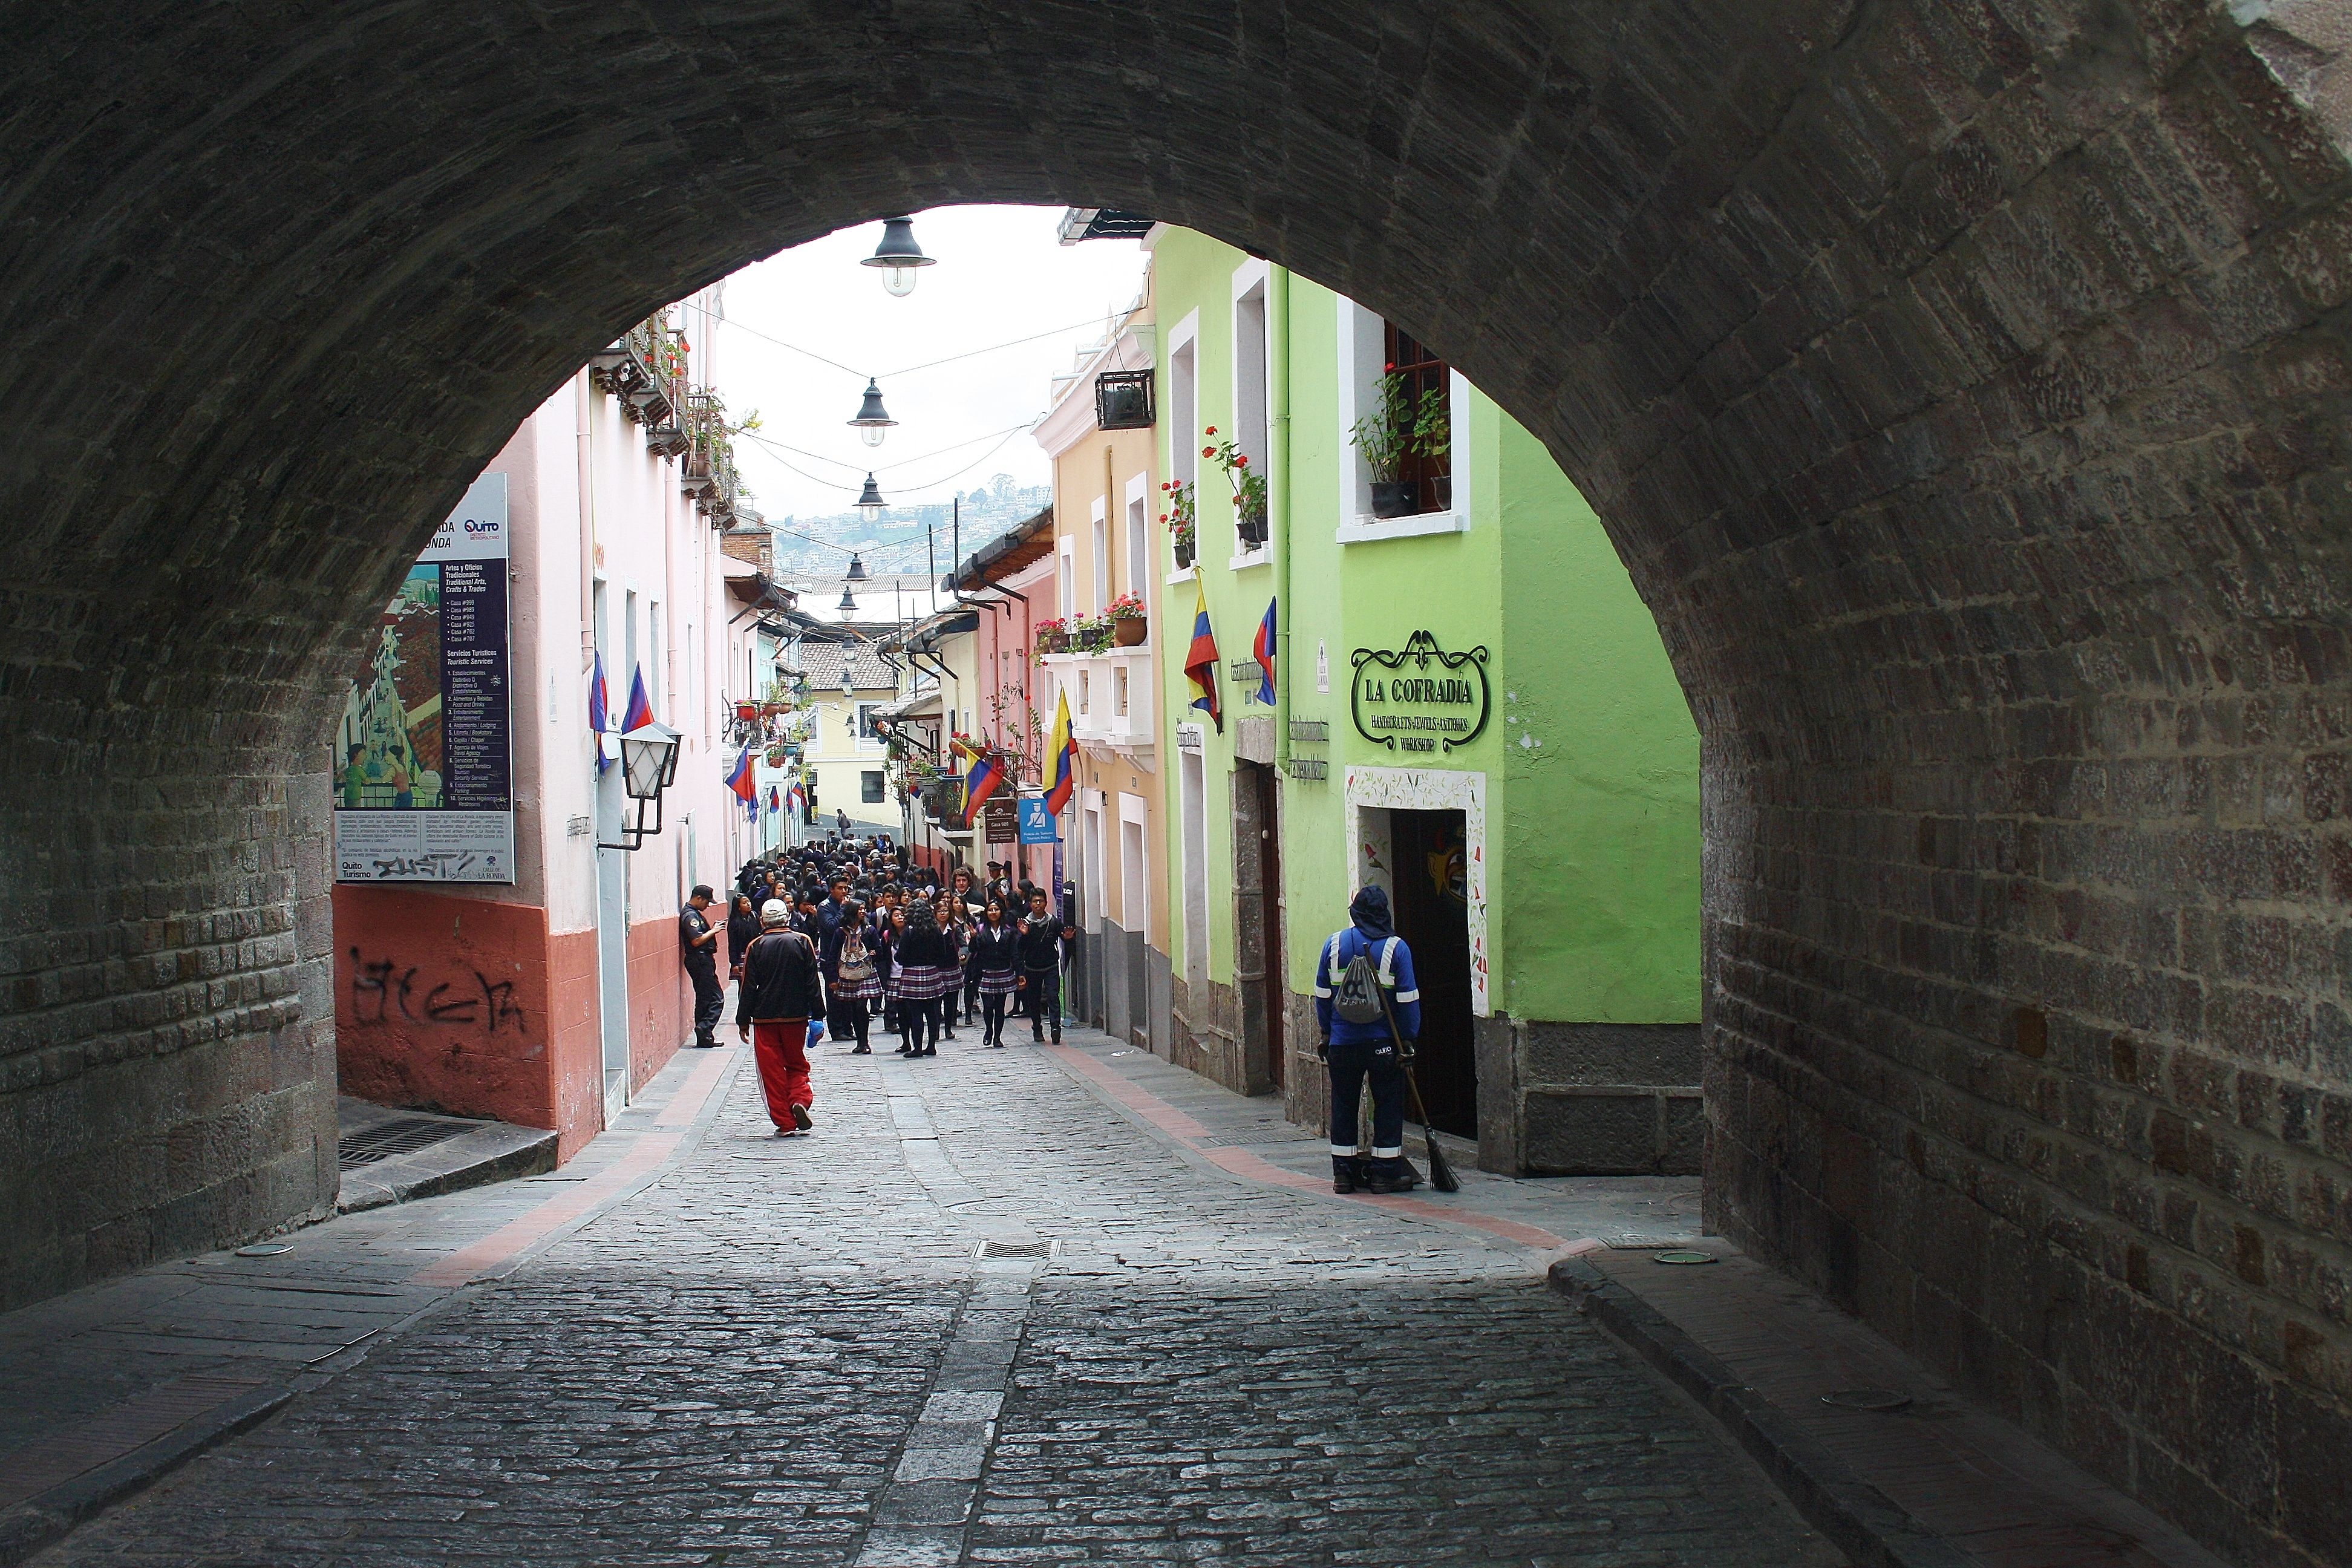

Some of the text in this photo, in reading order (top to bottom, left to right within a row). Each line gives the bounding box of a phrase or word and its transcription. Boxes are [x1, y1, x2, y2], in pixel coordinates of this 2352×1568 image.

[1365, 670, 1472, 703] LA COFRADÍA
[1400, 737, 1434, 751] WORKSHOP
